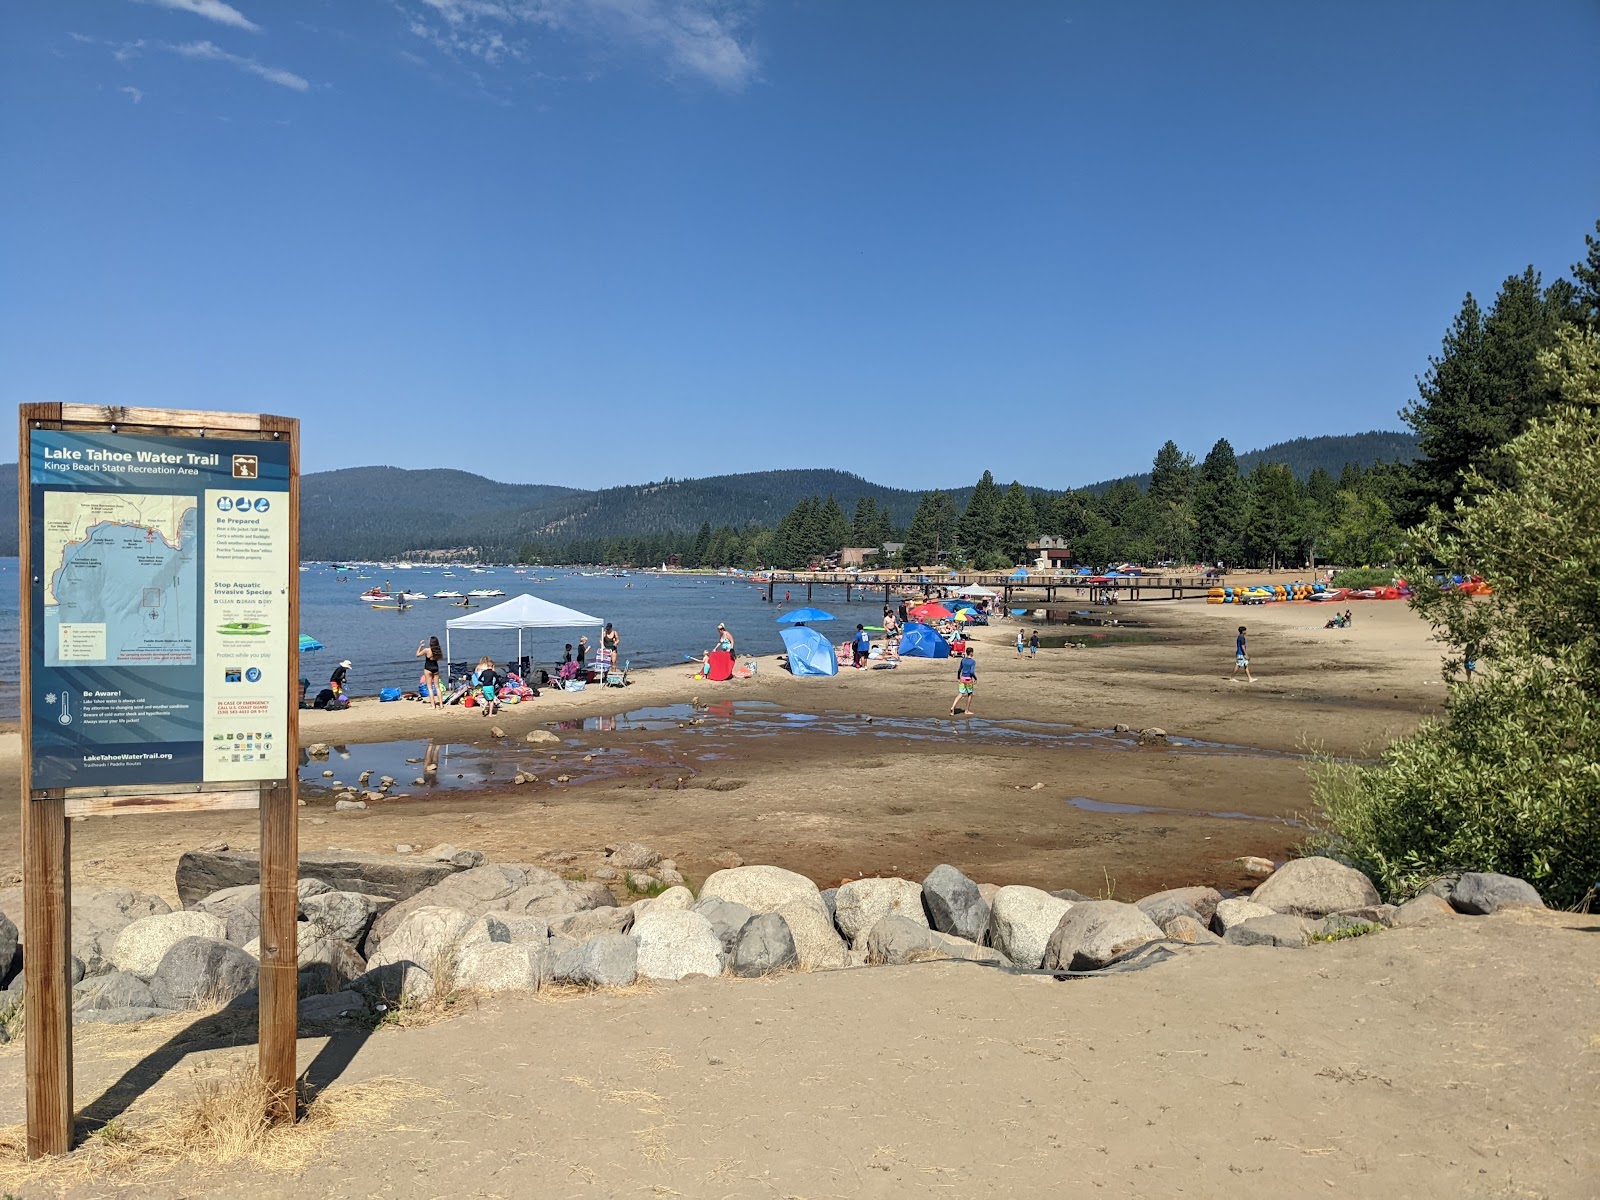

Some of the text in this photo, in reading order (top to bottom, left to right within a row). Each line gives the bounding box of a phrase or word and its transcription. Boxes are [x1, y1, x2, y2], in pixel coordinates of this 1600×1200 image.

[44, 447, 219, 466] Lake Tahoe Water Trail
[44, 462, 199, 475] Kings Beach State Recreation Area
[84, 753, 172, 761] LakeTahoeWaterTrail.org
